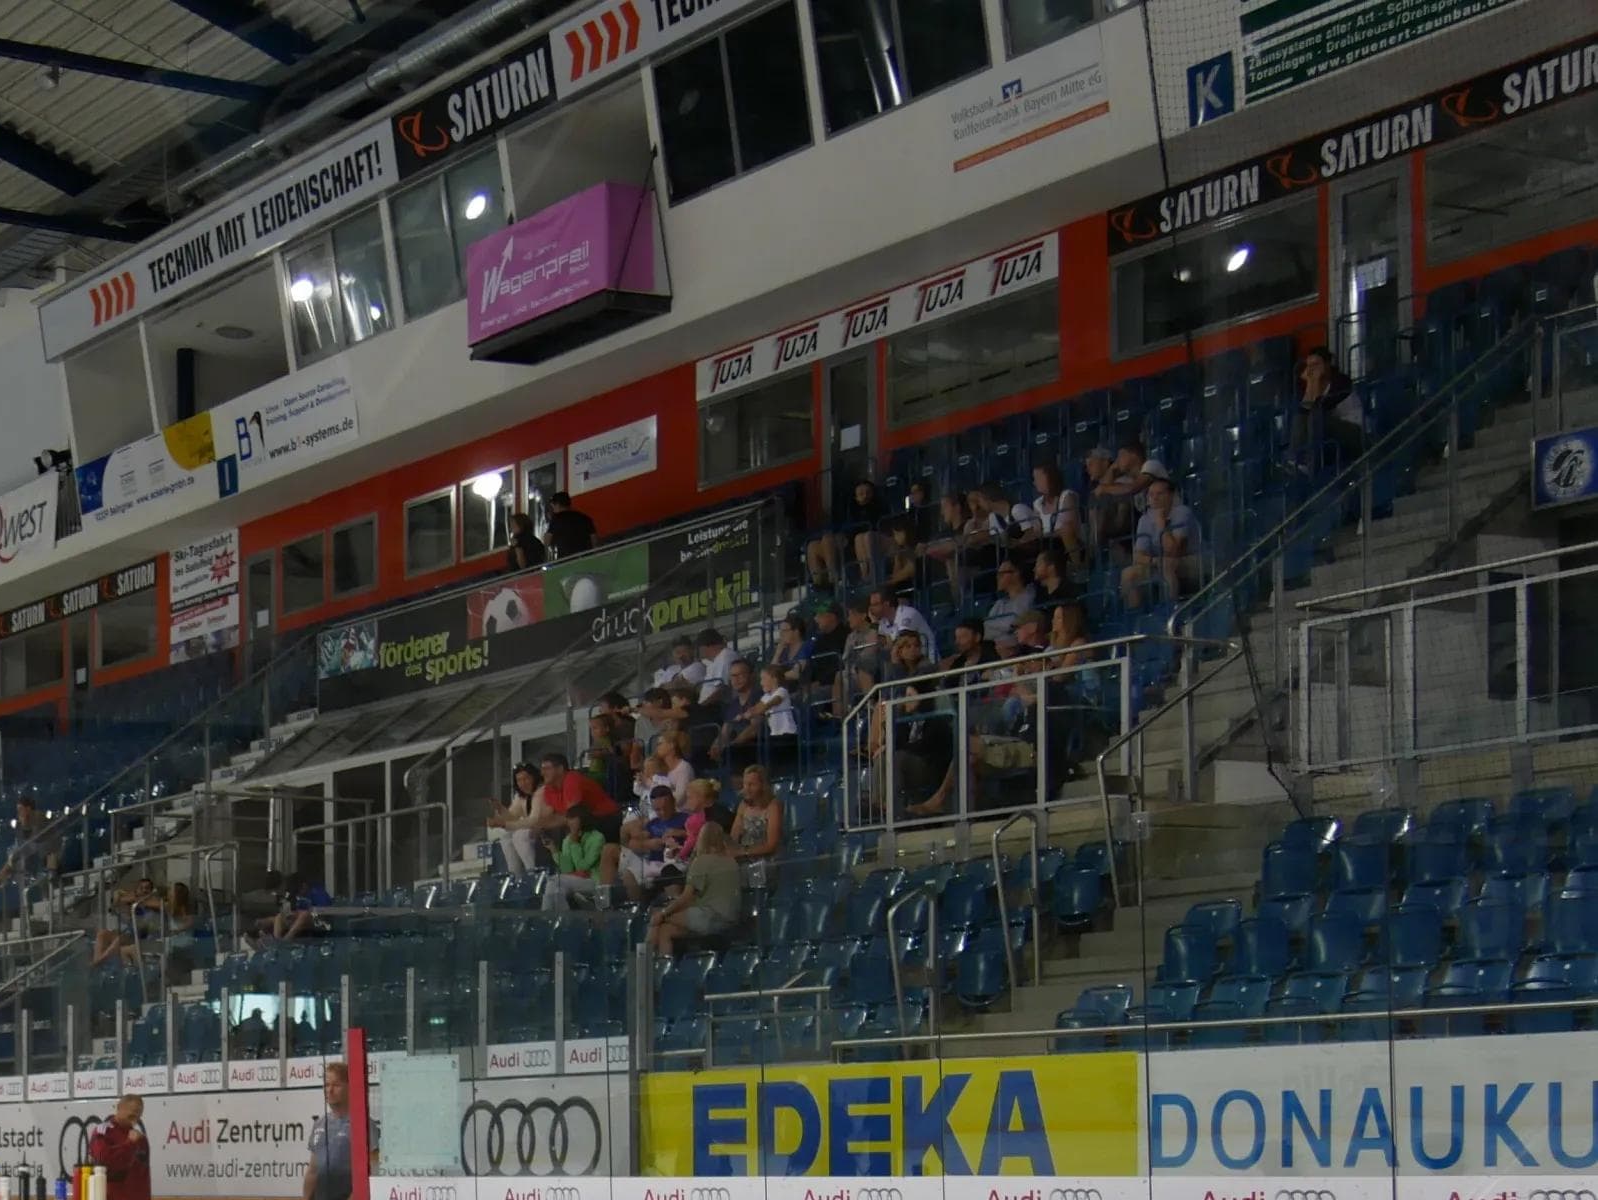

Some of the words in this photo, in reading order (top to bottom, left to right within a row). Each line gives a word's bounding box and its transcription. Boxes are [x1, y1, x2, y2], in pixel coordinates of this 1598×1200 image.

[1355, 12, 1376, 27] Art
[448, 48, 550, 143] SATURN
[951, 96, 995, 124] Volksbank
[1023, 90, 1057, 113] Bayern
[1060, 78, 1086, 98] Mitte
[1088, 70, 1102, 86] eG
[1195, 64, 1224, 112] K
[1159, 165, 1259, 234] SATURN
[1320, 105, 1433, 178] SATURN
[148, 230, 214, 293] TECHNIK
[216, 212, 247, 258] MIT
[252, 140, 383, 239] LEIDENSCHAFT!
[711, 347, 754, 392] TUJA
[774, 323, 820, 370] TUJA
[842, 297, 890, 348] TUJA
[916, 269, 967, 322] TUJA
[990, 241, 1045, 295] TUJA
[11, 601, 45, 632] SATURN
[63, 583, 99, 615] SATURN
[117, 561, 155, 595] SATURN
[379, 631, 450, 670] förderer
[425, 640, 489, 685] sports!
[30, 1081, 49, 1094] Audi
[76, 1078, 95, 1090] Audi
[125, 1076, 145, 1088] Audi
[177, 1072, 198, 1085] Audi
[231, 1068, 254, 1082] Audi
[289, 1064, 314, 1079] Audi
[490, 1053, 520, 1069] Audi
[569, 1048, 602, 1064] Audi
[166, 1120, 210, 1145] Audi
[216, 1119, 304, 1144] Zentrum
[692, 1068, 1057, 1177] EDEKA
